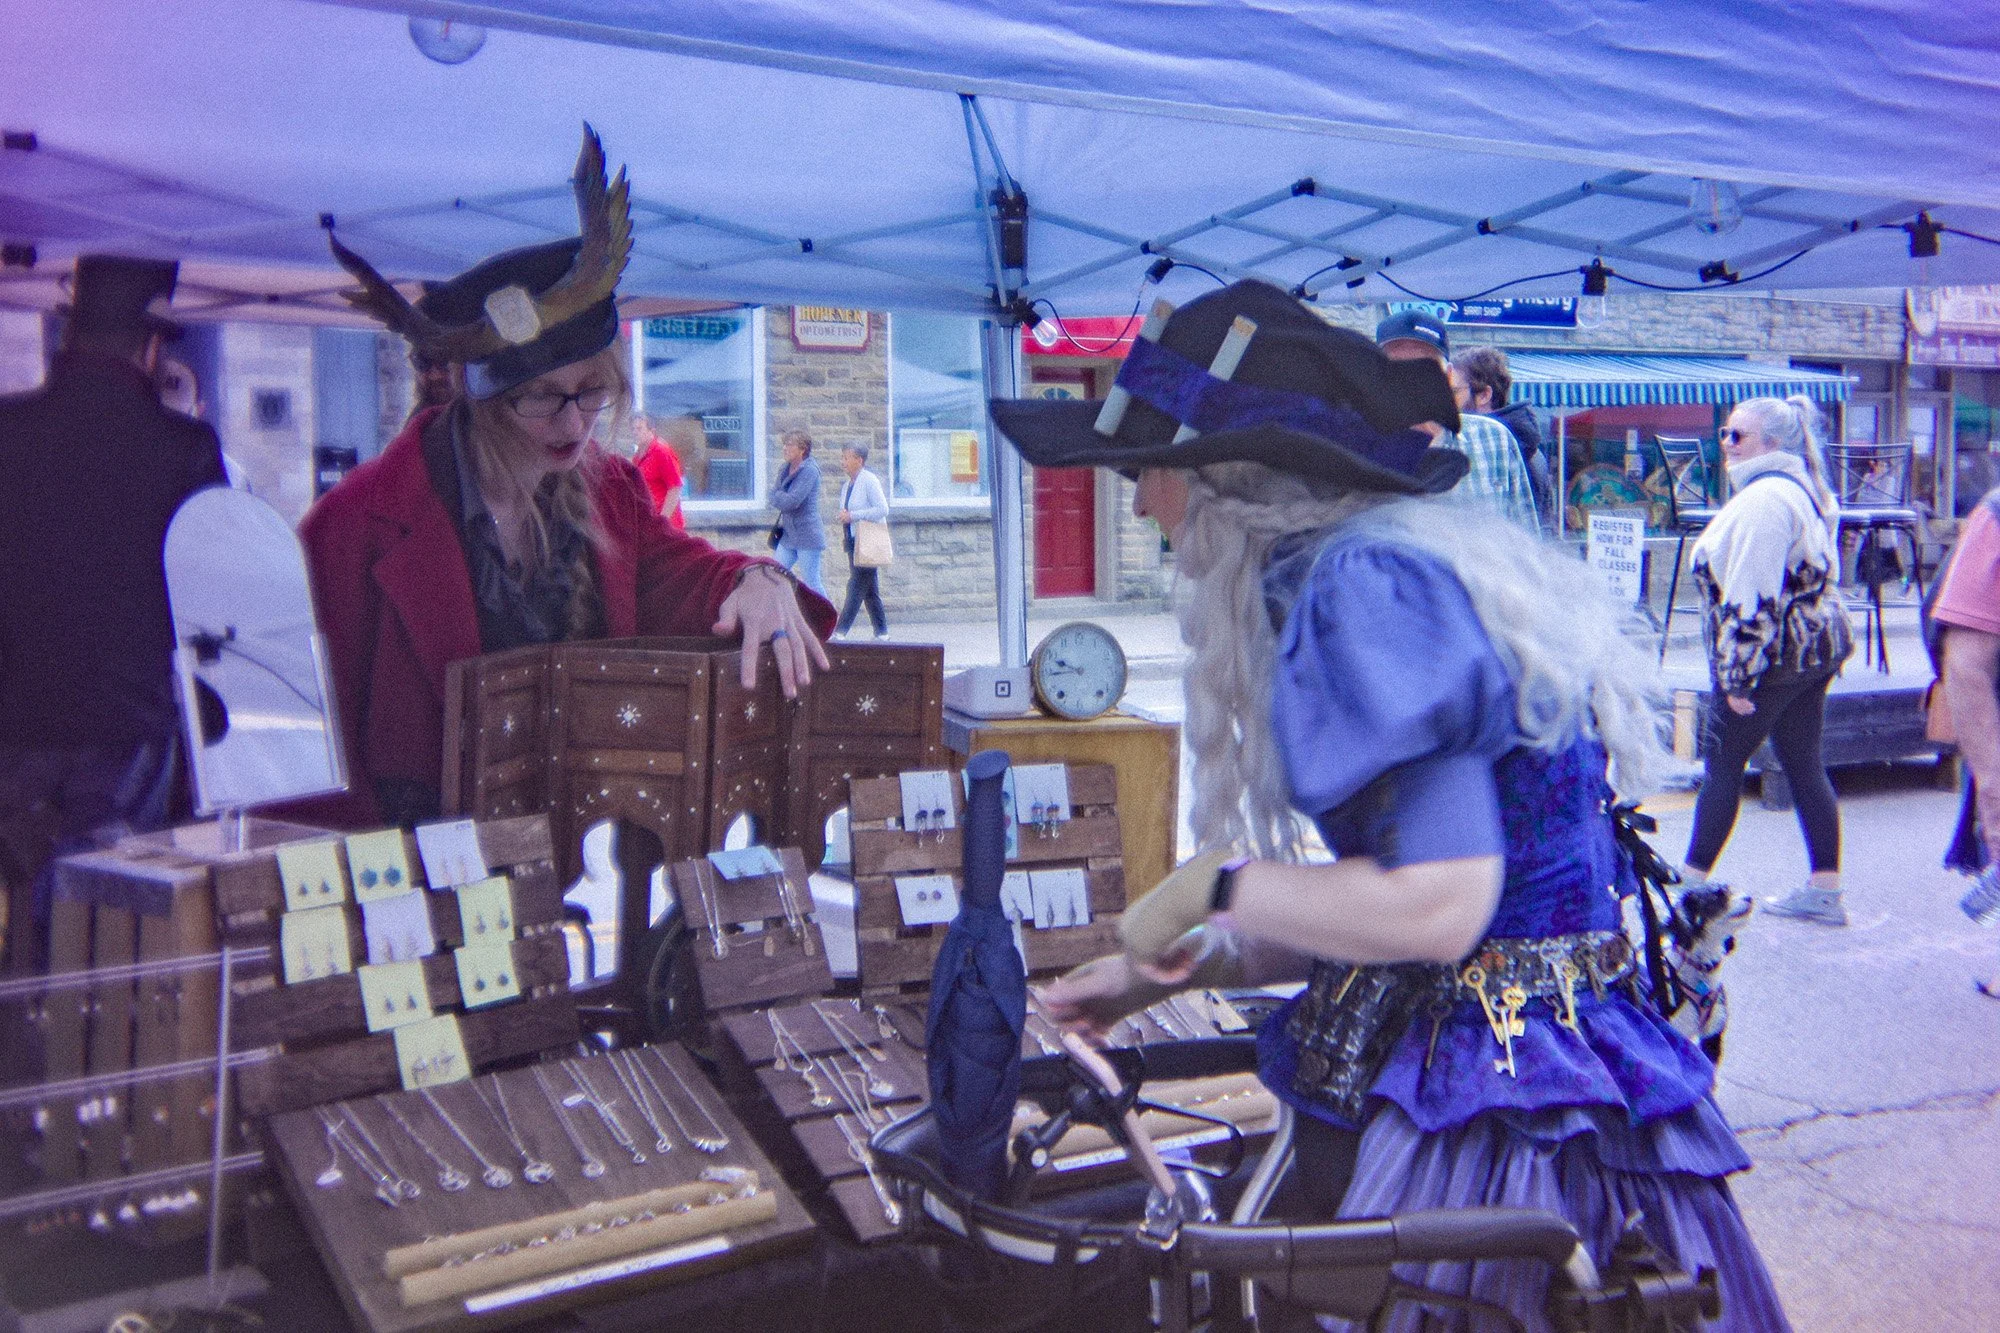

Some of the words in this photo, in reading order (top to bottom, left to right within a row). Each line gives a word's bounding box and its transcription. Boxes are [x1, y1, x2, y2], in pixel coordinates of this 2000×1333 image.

[799, 324, 864, 338] OPTOMETRIST
[1593, 520, 1634, 533] REGISTER
[1596, 533, 1614, 544] NOW
[1616, 535, 1634, 545] FOR
[1605, 546, 1626, 558] FALL
[1598, 559, 1638, 573] CLASSES
